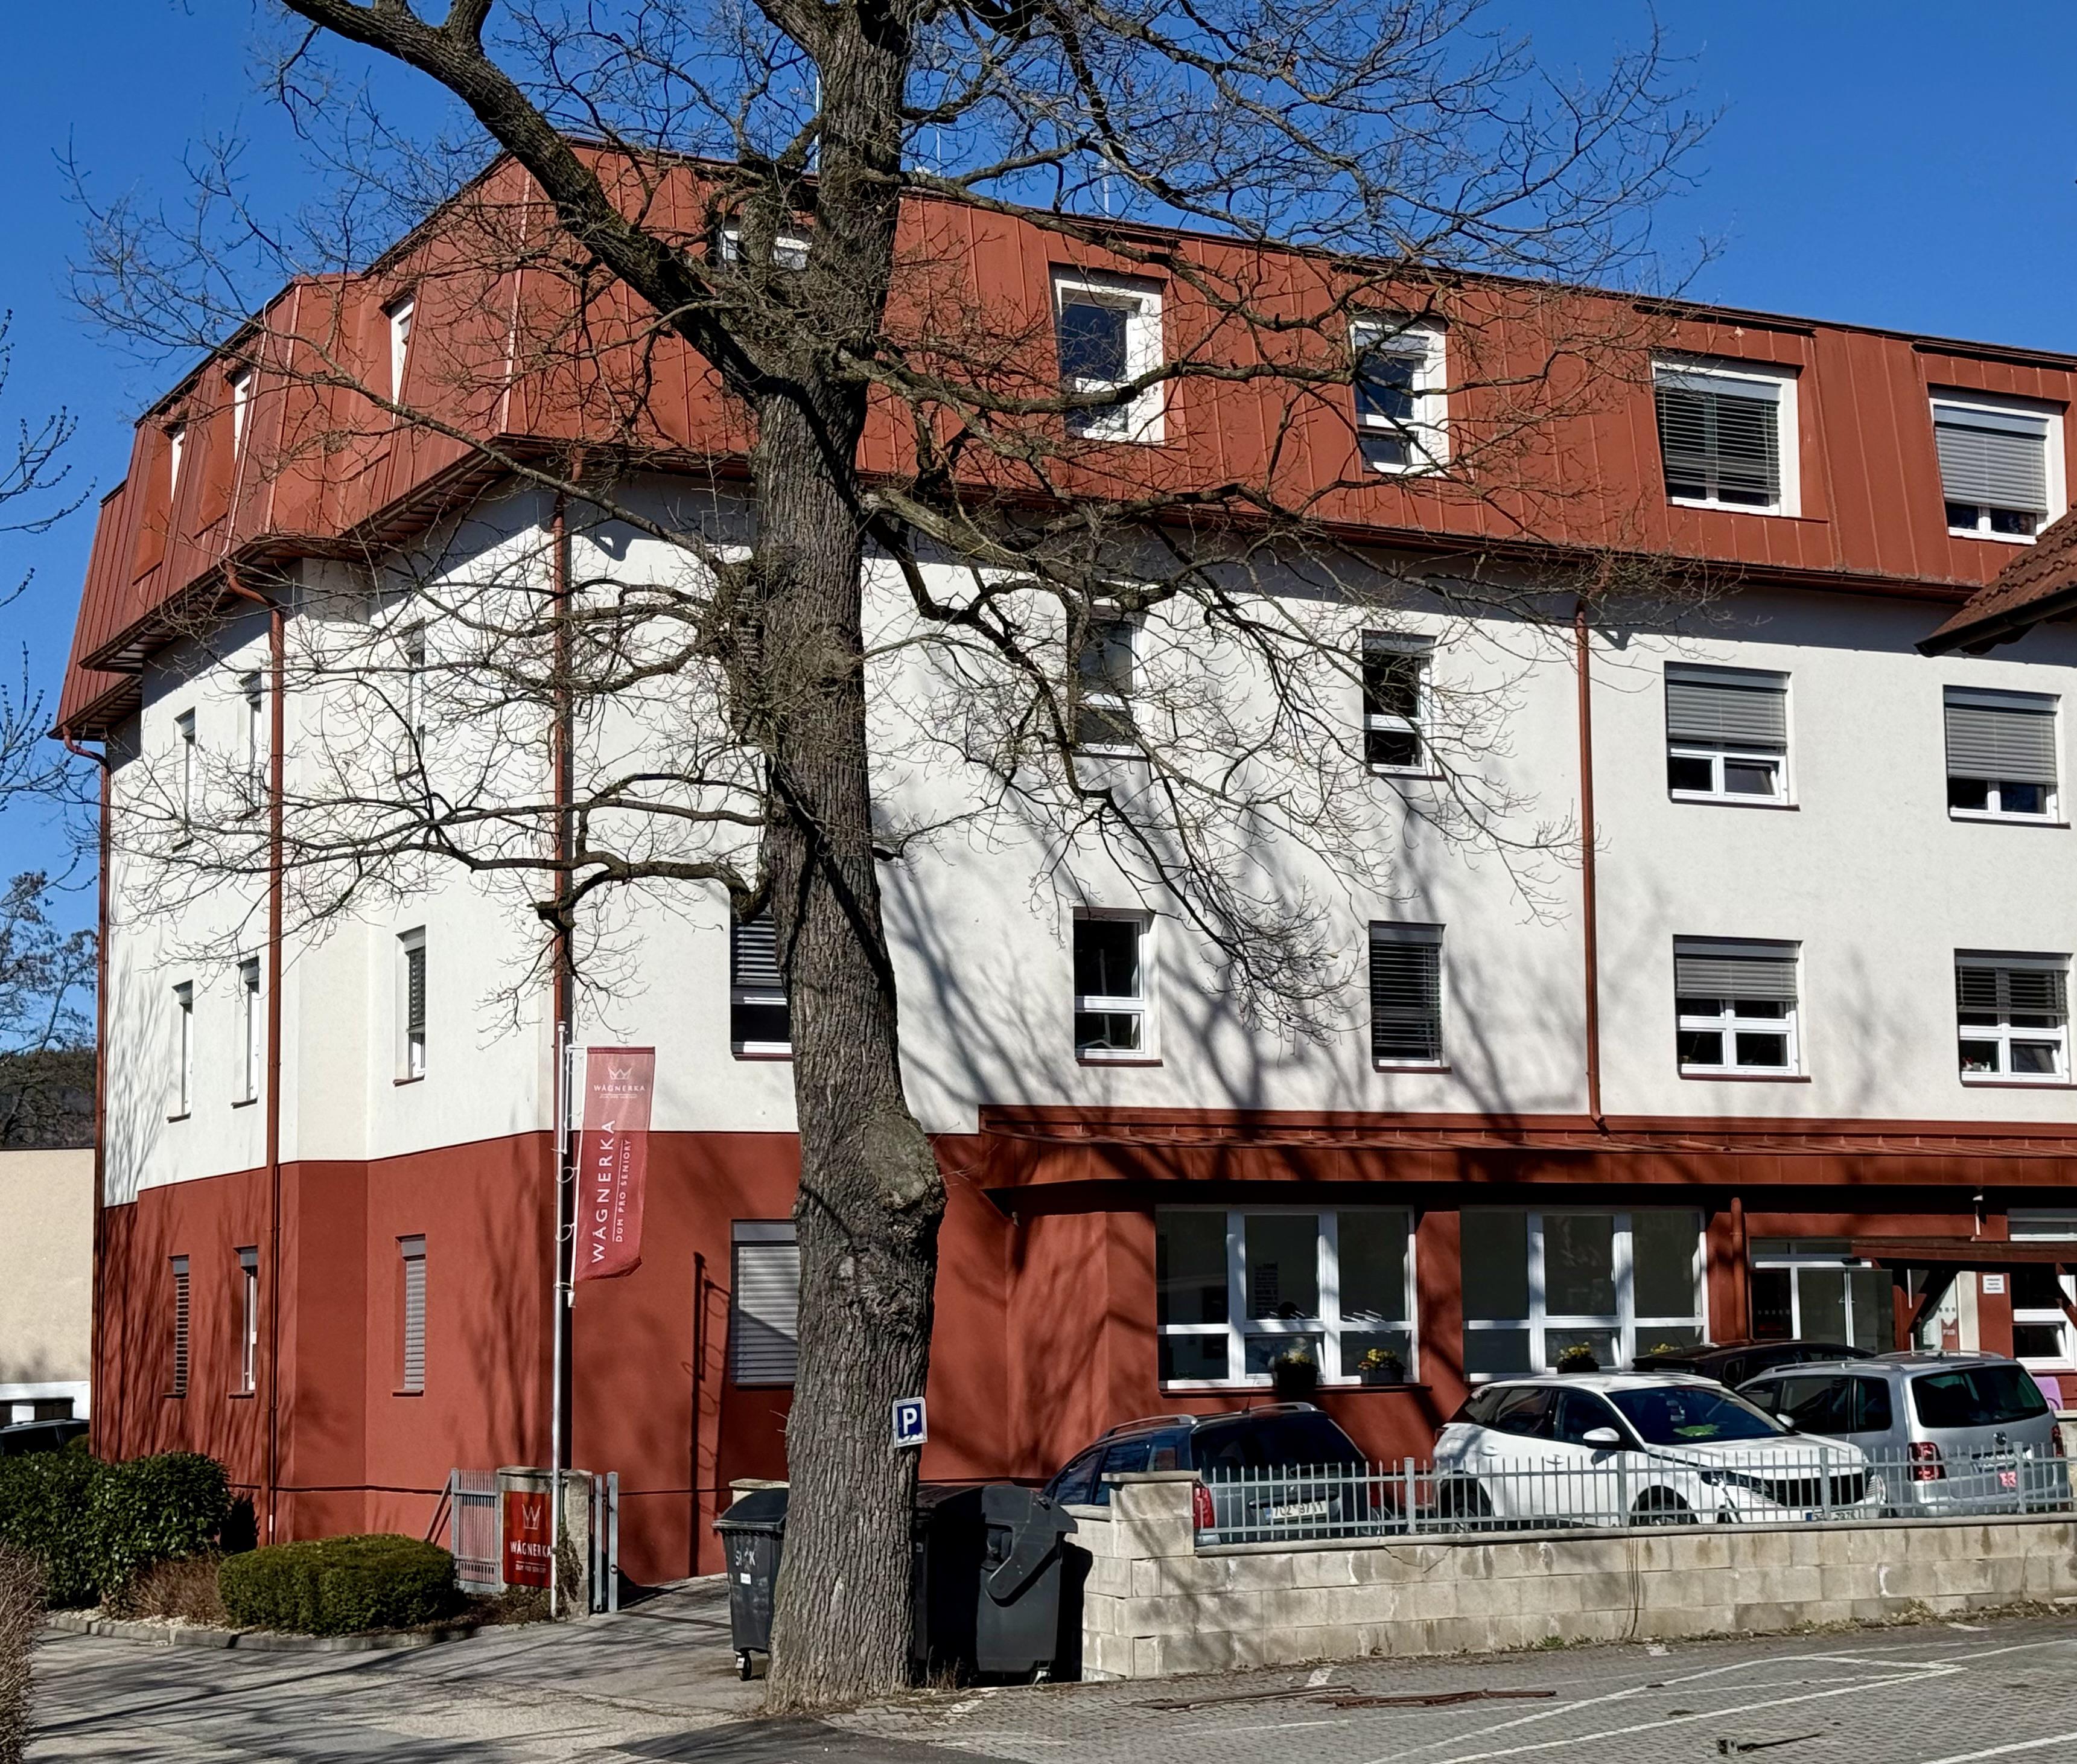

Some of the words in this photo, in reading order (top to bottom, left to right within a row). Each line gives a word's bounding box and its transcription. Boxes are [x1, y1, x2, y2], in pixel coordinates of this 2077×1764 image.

[620, 1139, 631, 1186] SENIORY
[591, 1120, 615, 1263] WÁGNERKA
[617, 1191, 626, 1213] PRO
[902, 1407, 918, 1434] P
